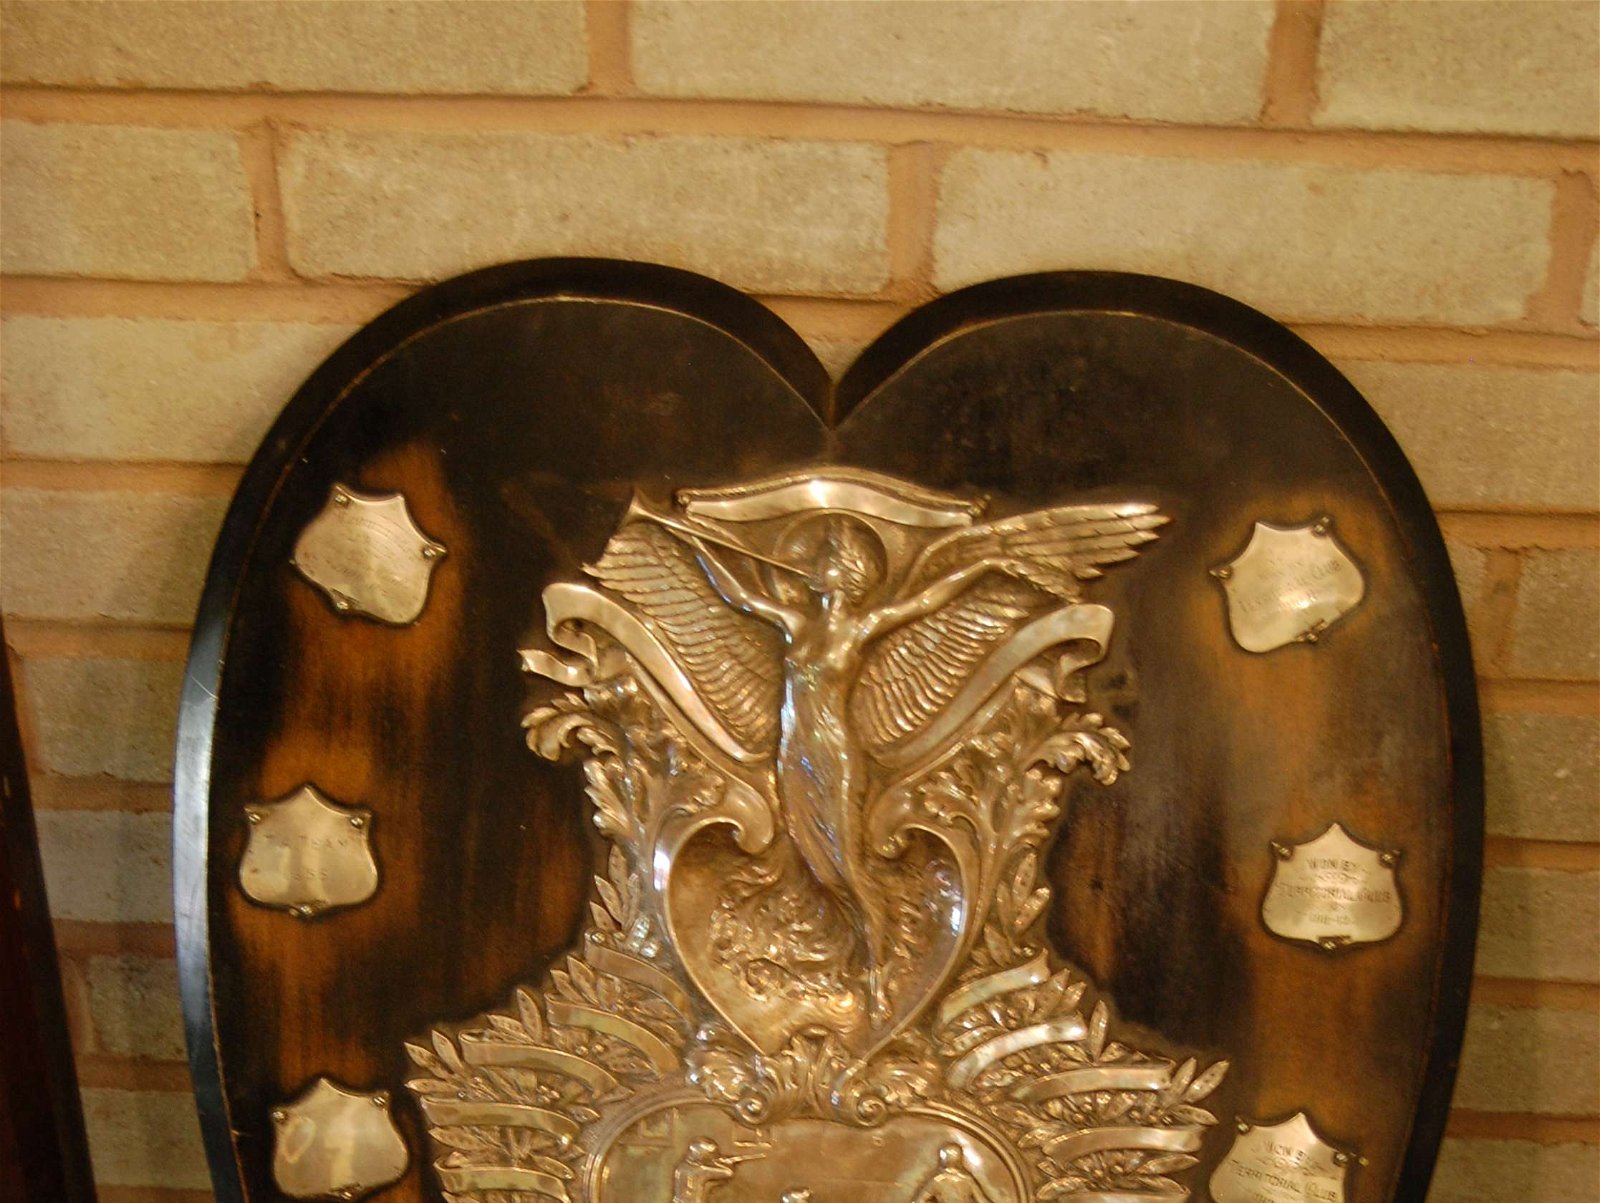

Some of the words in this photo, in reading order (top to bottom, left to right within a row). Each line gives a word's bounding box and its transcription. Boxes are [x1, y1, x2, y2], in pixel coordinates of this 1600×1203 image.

[1263, 1140, 1293, 1157] WON
[1230, 1158, 1301, 1193] TERRITORIAL
[1304, 1180, 1337, 1203] CLUB
